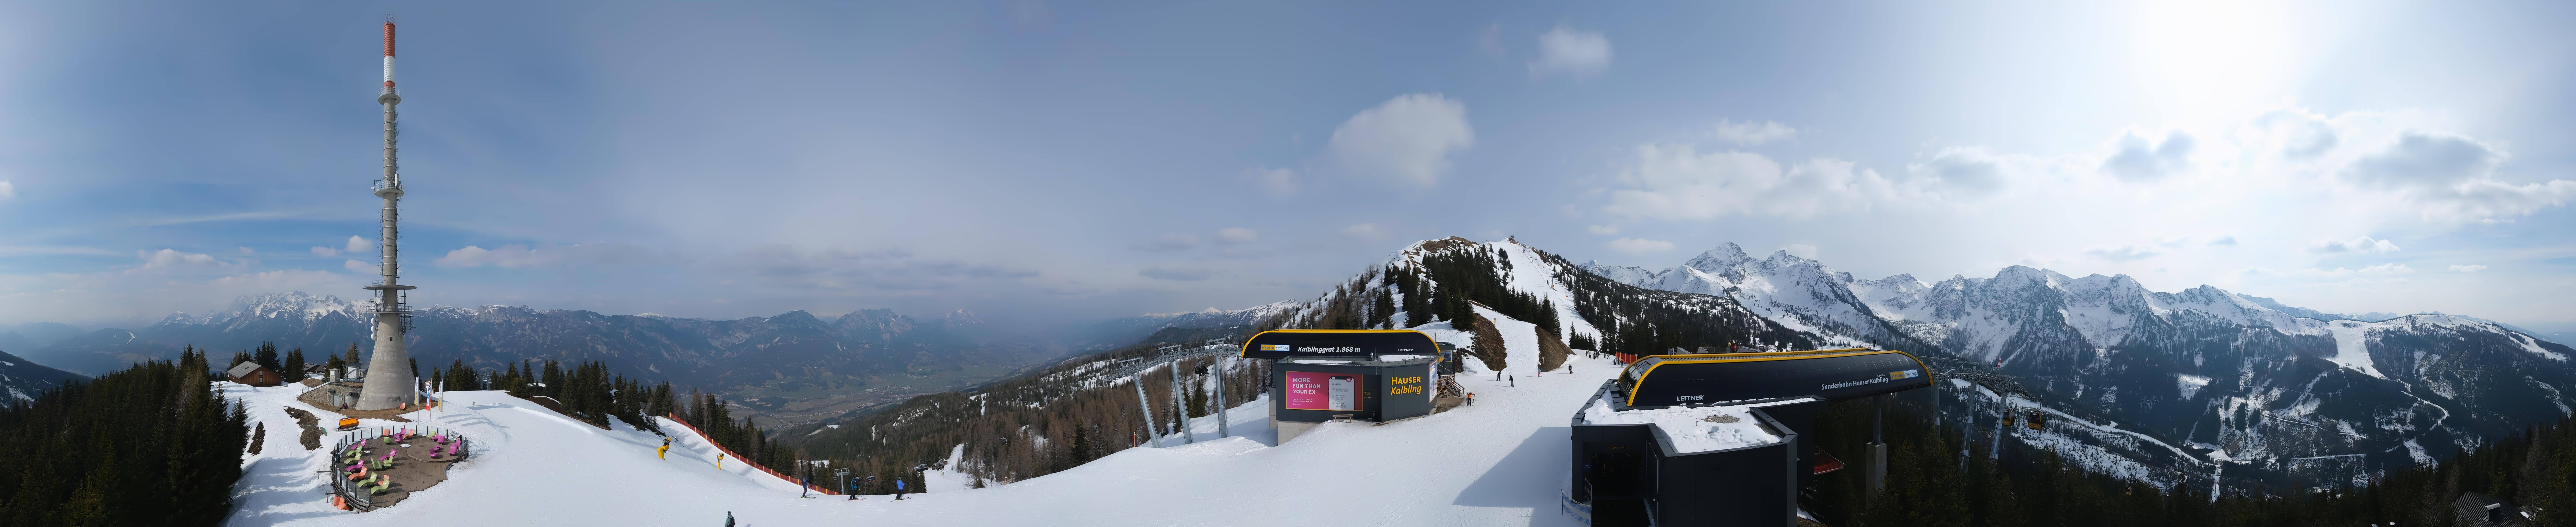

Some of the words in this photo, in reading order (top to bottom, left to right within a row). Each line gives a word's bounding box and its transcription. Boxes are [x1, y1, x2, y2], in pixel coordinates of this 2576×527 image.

[1391, 376, 1421, 385] HAUSER
[1391, 385, 1421, 395] Kaibling
[1821, 381, 1852, 390] Senderbahn
